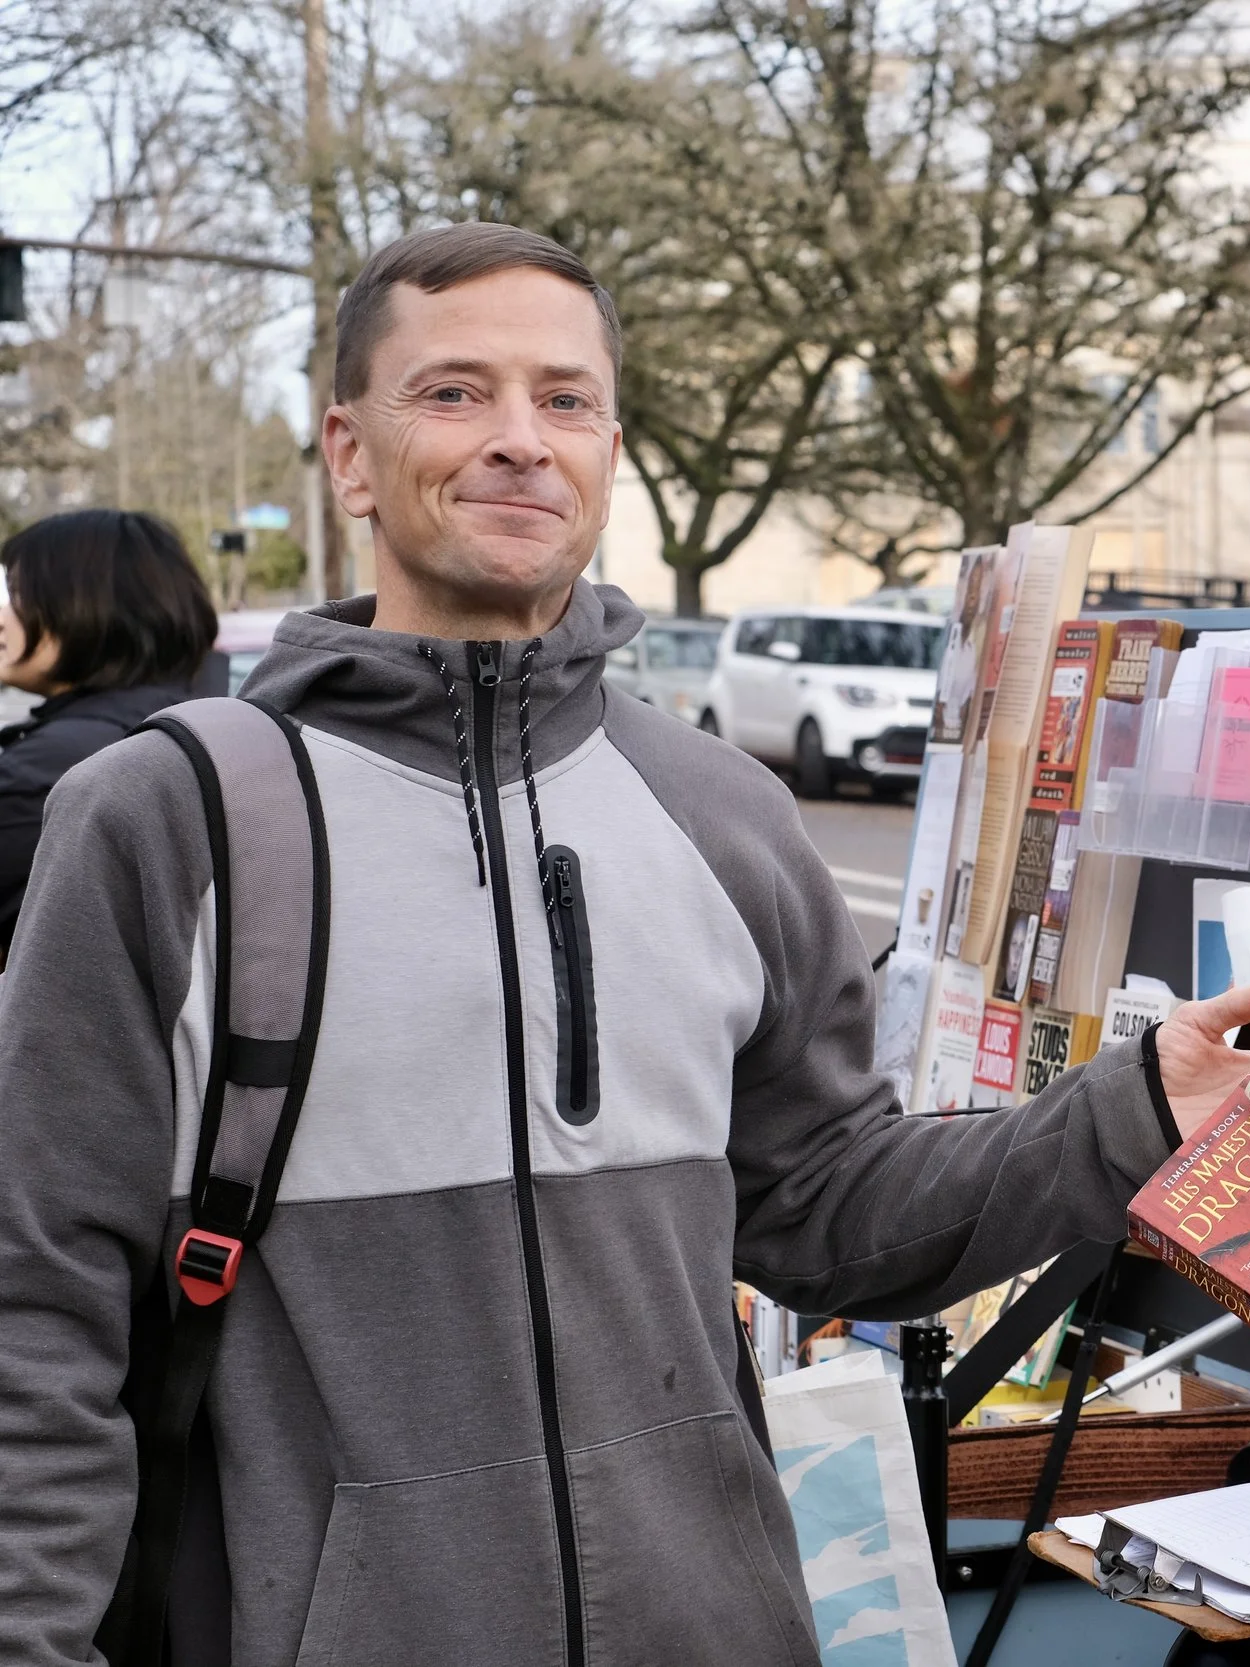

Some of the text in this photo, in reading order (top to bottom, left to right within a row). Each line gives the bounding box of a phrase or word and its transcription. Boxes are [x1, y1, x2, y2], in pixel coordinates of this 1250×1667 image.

[1065, 629, 1097, 641] walter
[1056, 648, 1090, 660] mosley
[1040, 771, 1056, 781] red
[1035, 786, 1064, 799] death
[1029, 1020, 1069, 1064] STUDS
[1023, 1058, 1064, 1096] TERK
[1161, 1142, 1209, 1190] TEMERAIRE
[1212, 1114, 1240, 1138] BOOK
[1164, 1181, 1200, 1215] HIS
[1181, 1249, 1198, 1268] HIS
[1175, 1256, 1250, 1322] DRAGON
